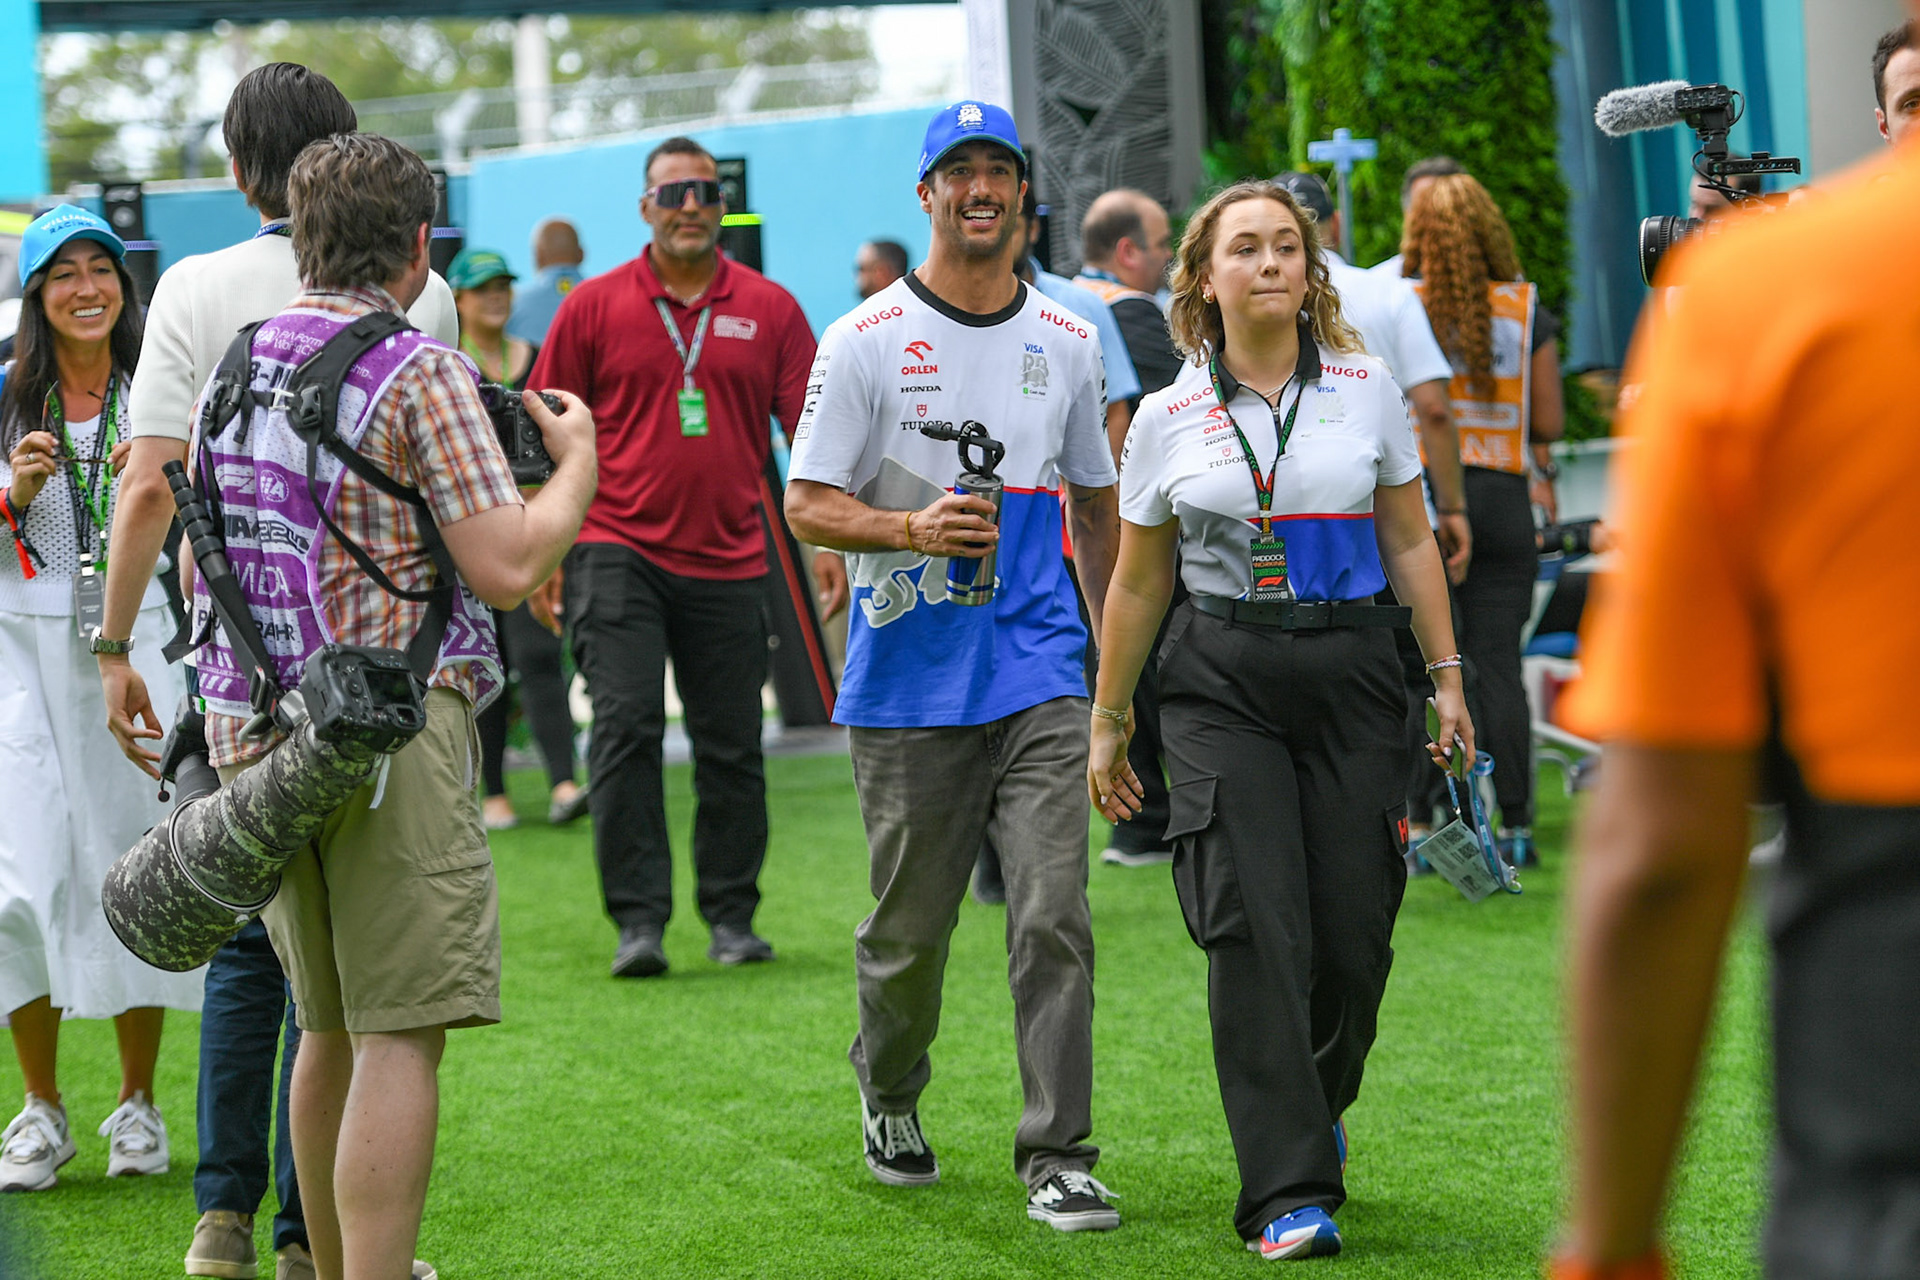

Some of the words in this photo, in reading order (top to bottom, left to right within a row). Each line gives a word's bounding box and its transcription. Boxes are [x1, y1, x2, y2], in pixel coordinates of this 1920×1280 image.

[855, 306, 903, 333] HUGO
[1040, 309, 1088, 339] HUGO
[1023, 342, 1045, 355] VISA
[901, 364, 938, 376] ORLEN
[1320, 363, 1368, 380] HUGO
[900, 385, 942, 394] HONDA
[1315, 385, 1337, 393] VISA
[1166, 387, 1214, 416] HUGO
[1208, 454, 1248, 469] TUDOR
